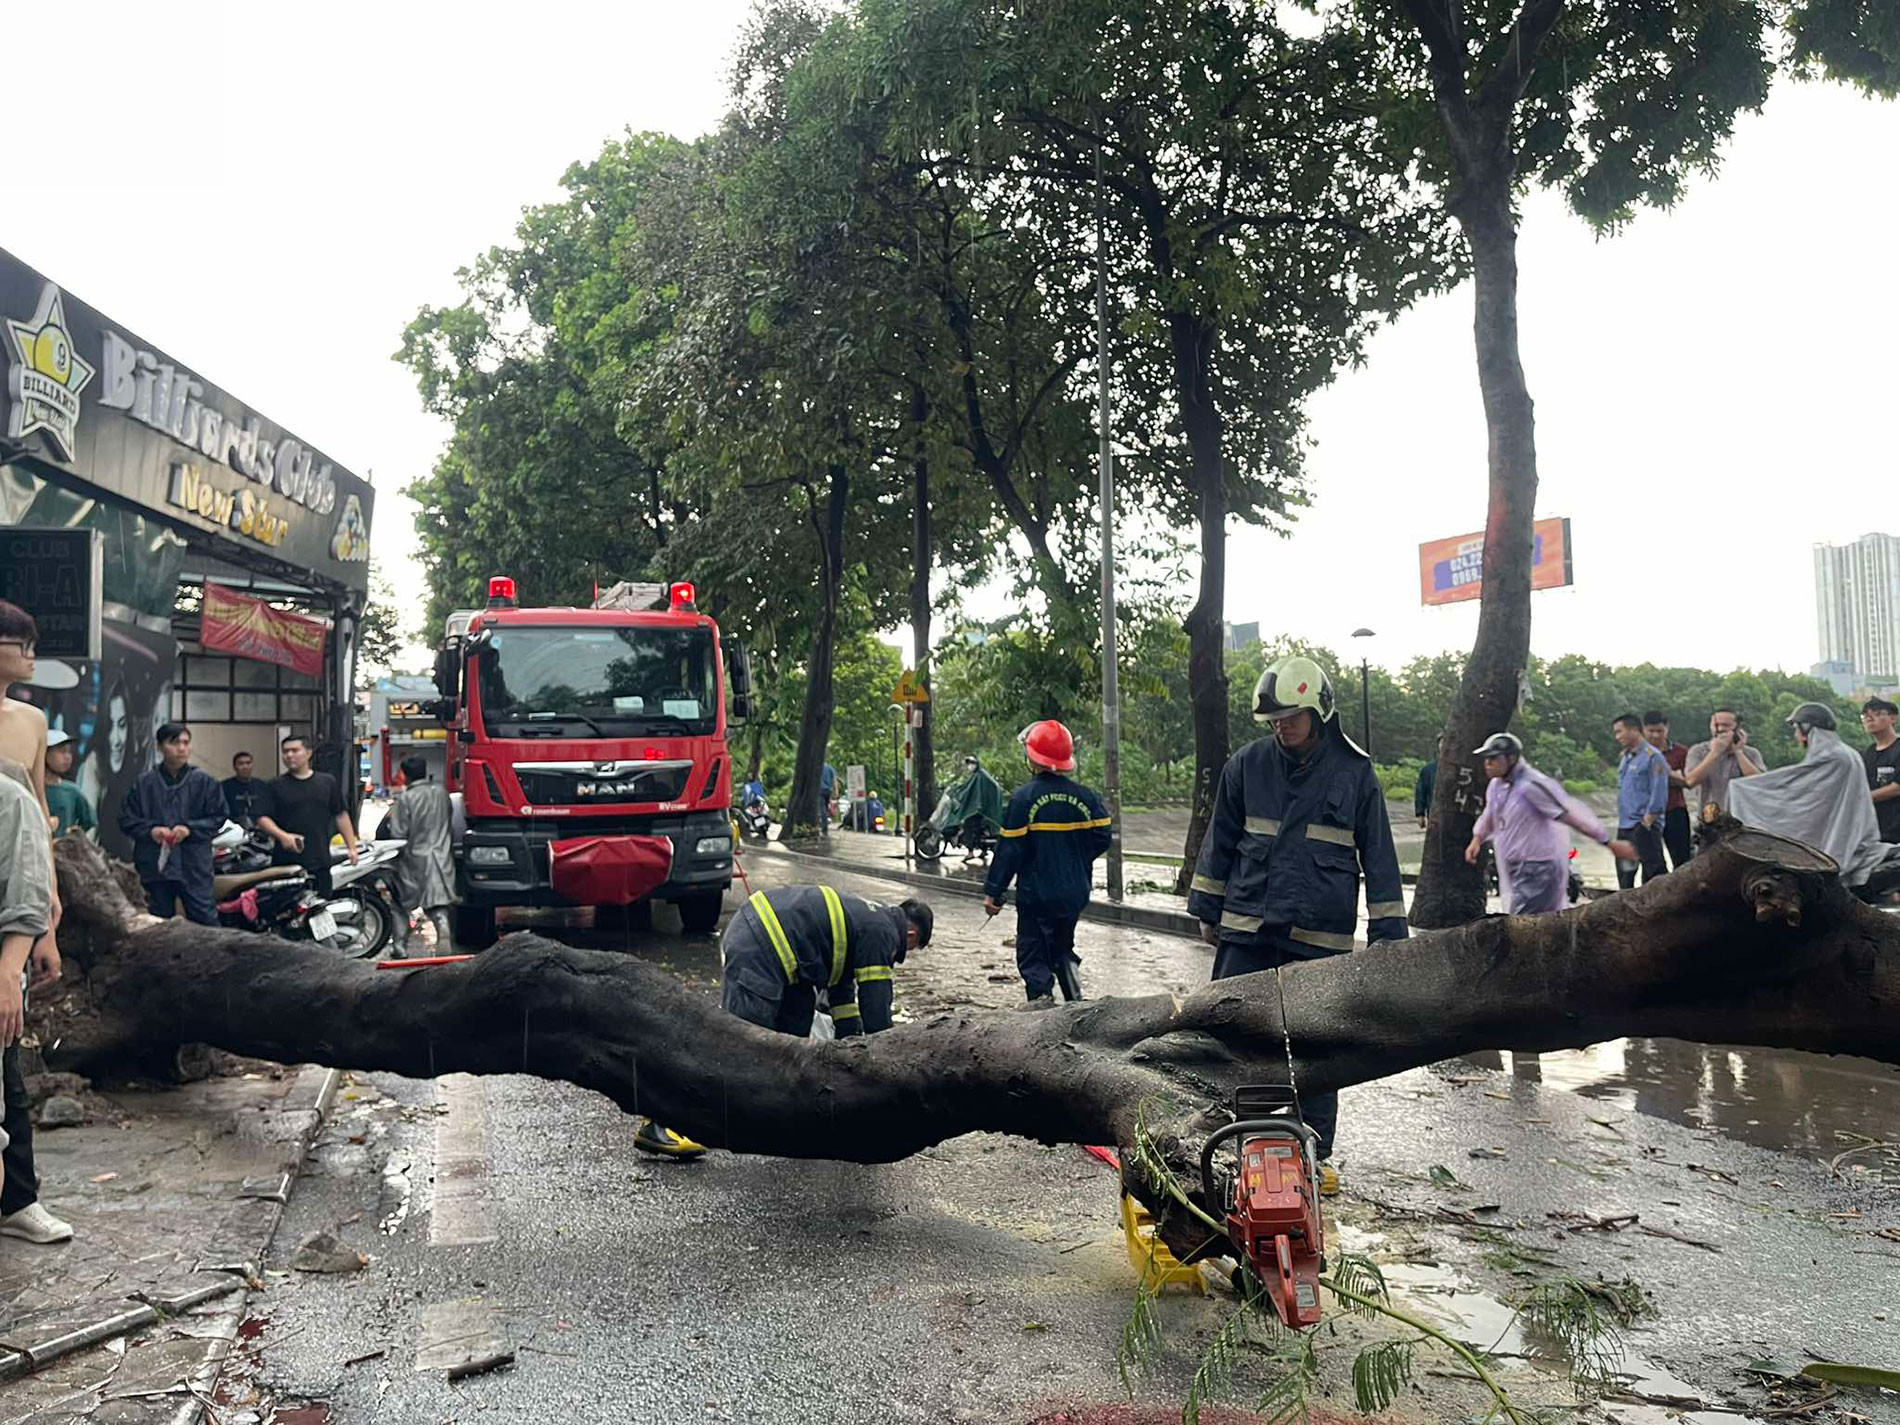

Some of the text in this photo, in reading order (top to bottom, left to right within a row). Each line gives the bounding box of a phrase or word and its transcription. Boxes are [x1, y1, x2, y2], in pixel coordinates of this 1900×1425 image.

[23, 376, 76, 415] BILLIARD
[98, 329, 336, 515] Billiards Club
[170, 463, 288, 545] New Star
[9, 539, 70, 558] CLUB
[577, 782, 635, 795] MAN
